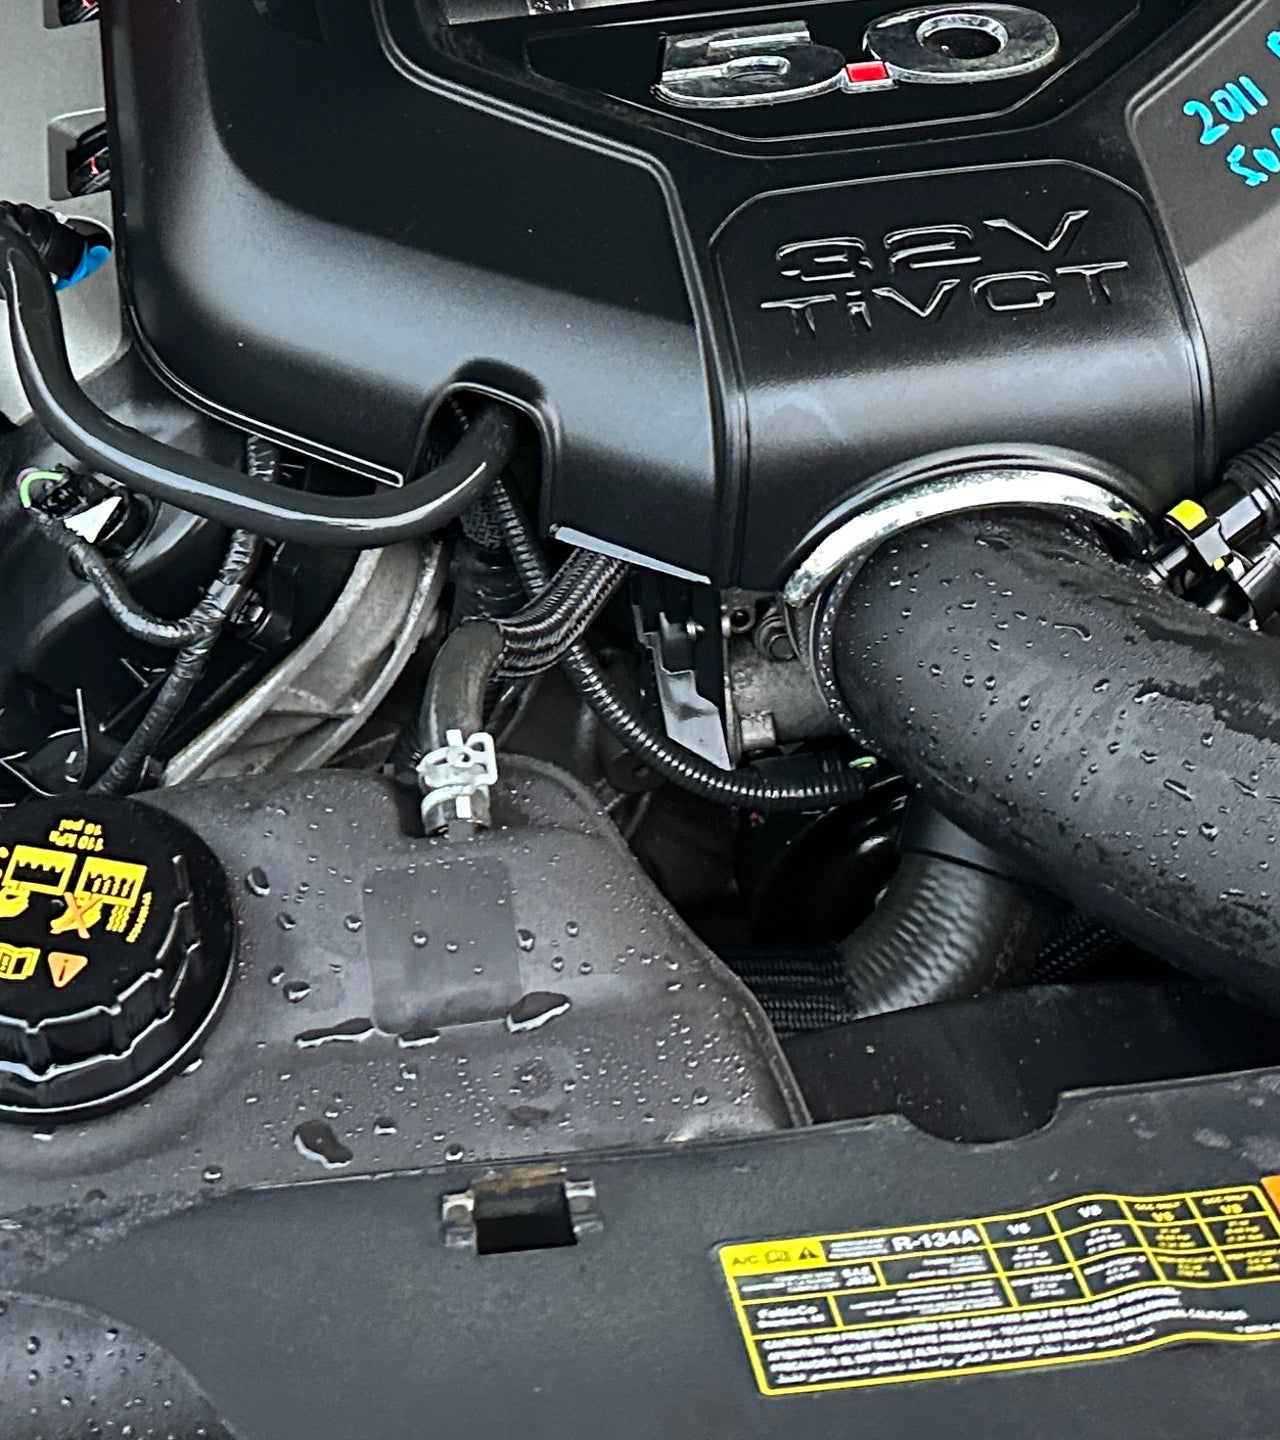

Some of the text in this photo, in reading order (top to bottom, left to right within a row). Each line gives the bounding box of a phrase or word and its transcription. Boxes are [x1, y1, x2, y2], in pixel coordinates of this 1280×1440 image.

[650, 2, 1060, 110] 5.0
[1183, 75, 1269, 146] 2011
[776, 209, 1089, 282] 32V
[731, 1254, 759, 1267] A/C
[890, 1227, 981, 1252] R-134A
